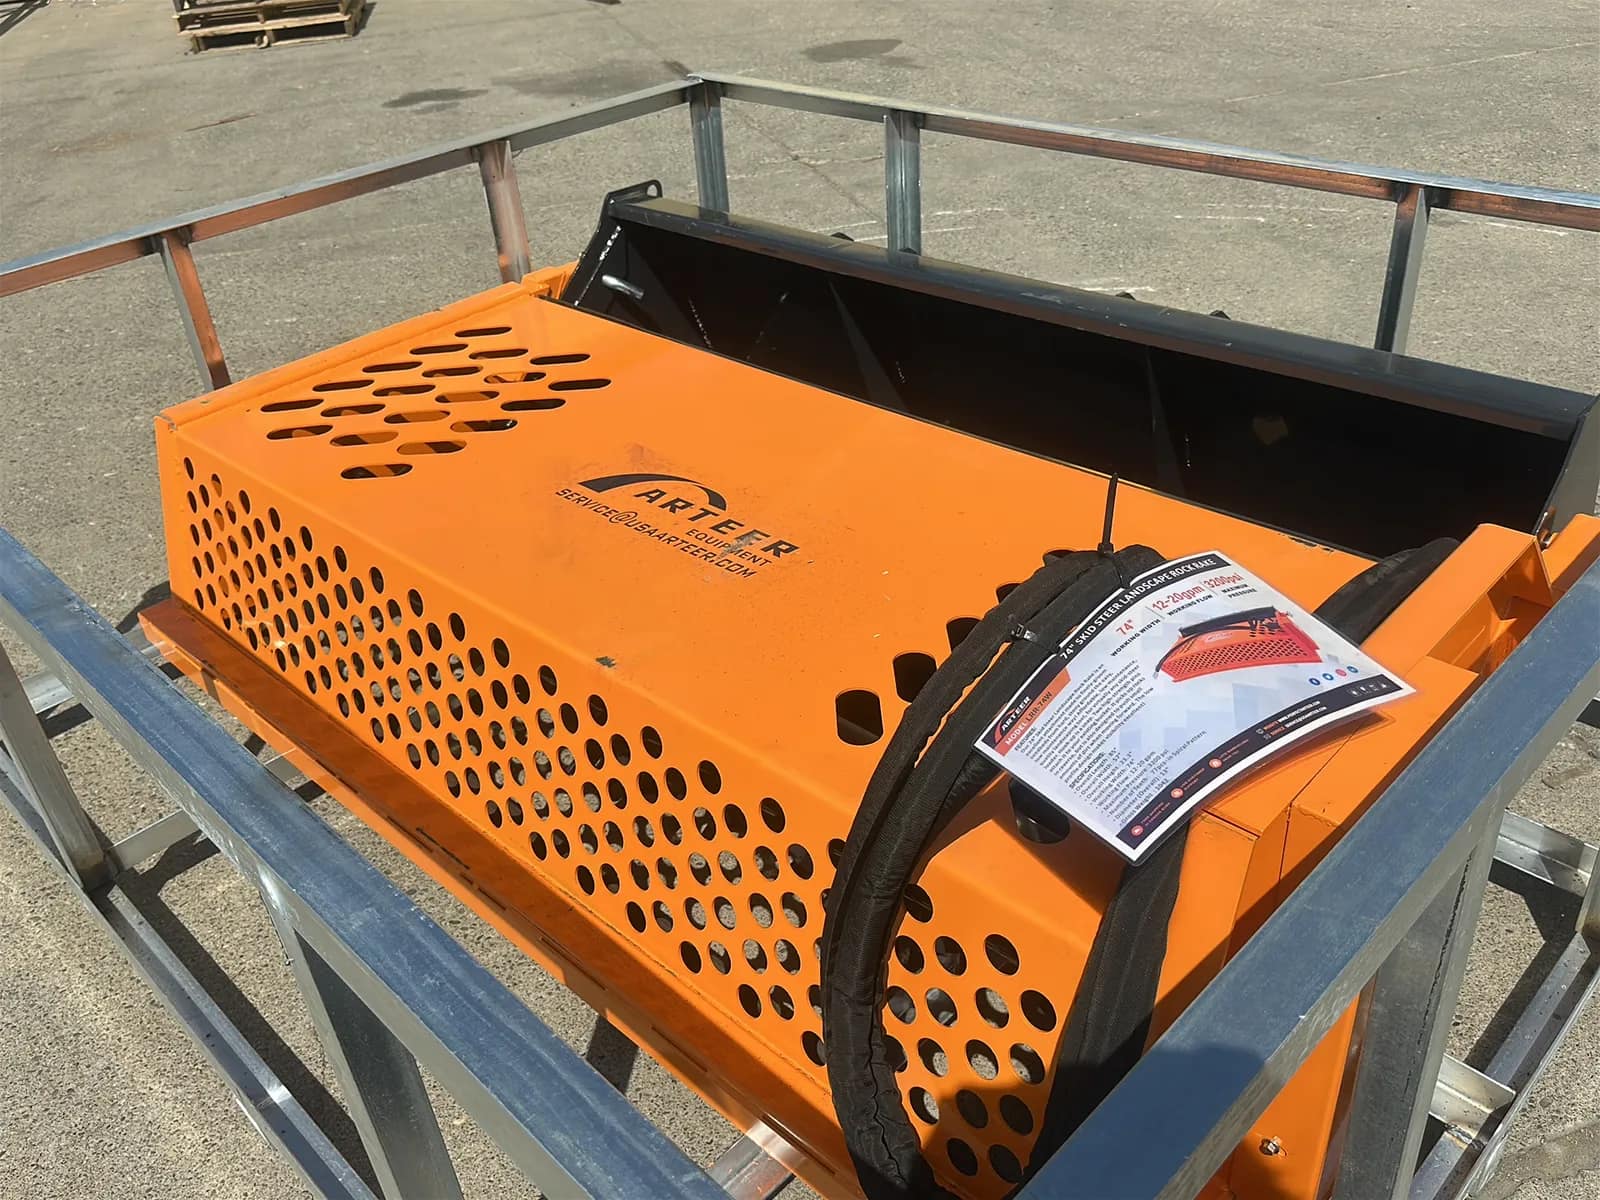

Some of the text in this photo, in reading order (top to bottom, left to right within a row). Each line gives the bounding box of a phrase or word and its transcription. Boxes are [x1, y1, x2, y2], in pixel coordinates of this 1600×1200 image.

[554, 488, 758, 579] SERVICE@USAARTEER.COM
[633, 488, 801, 559] ARTEER
[1204, 572, 1245, 589] 3200psi
[1221, 583, 1248, 593] MAXIMUM
[1227, 588, 1257, 598] PRESSURE
[1059, 558, 1217, 660] 74" SKID STEER LANDSCAPE ROCK RAKE
[1152, 586, 1206, 611] 12-20gpm
[1167, 594, 1214, 616] WORKING FLOW
[1110, 618, 1161, 657] WORKING WIDTH
[1115, 618, 1134, 636] 74"
[1001, 696, 1031, 731] ARTEER
[1005, 691, 1053, 745] MODEL LRR-74W
